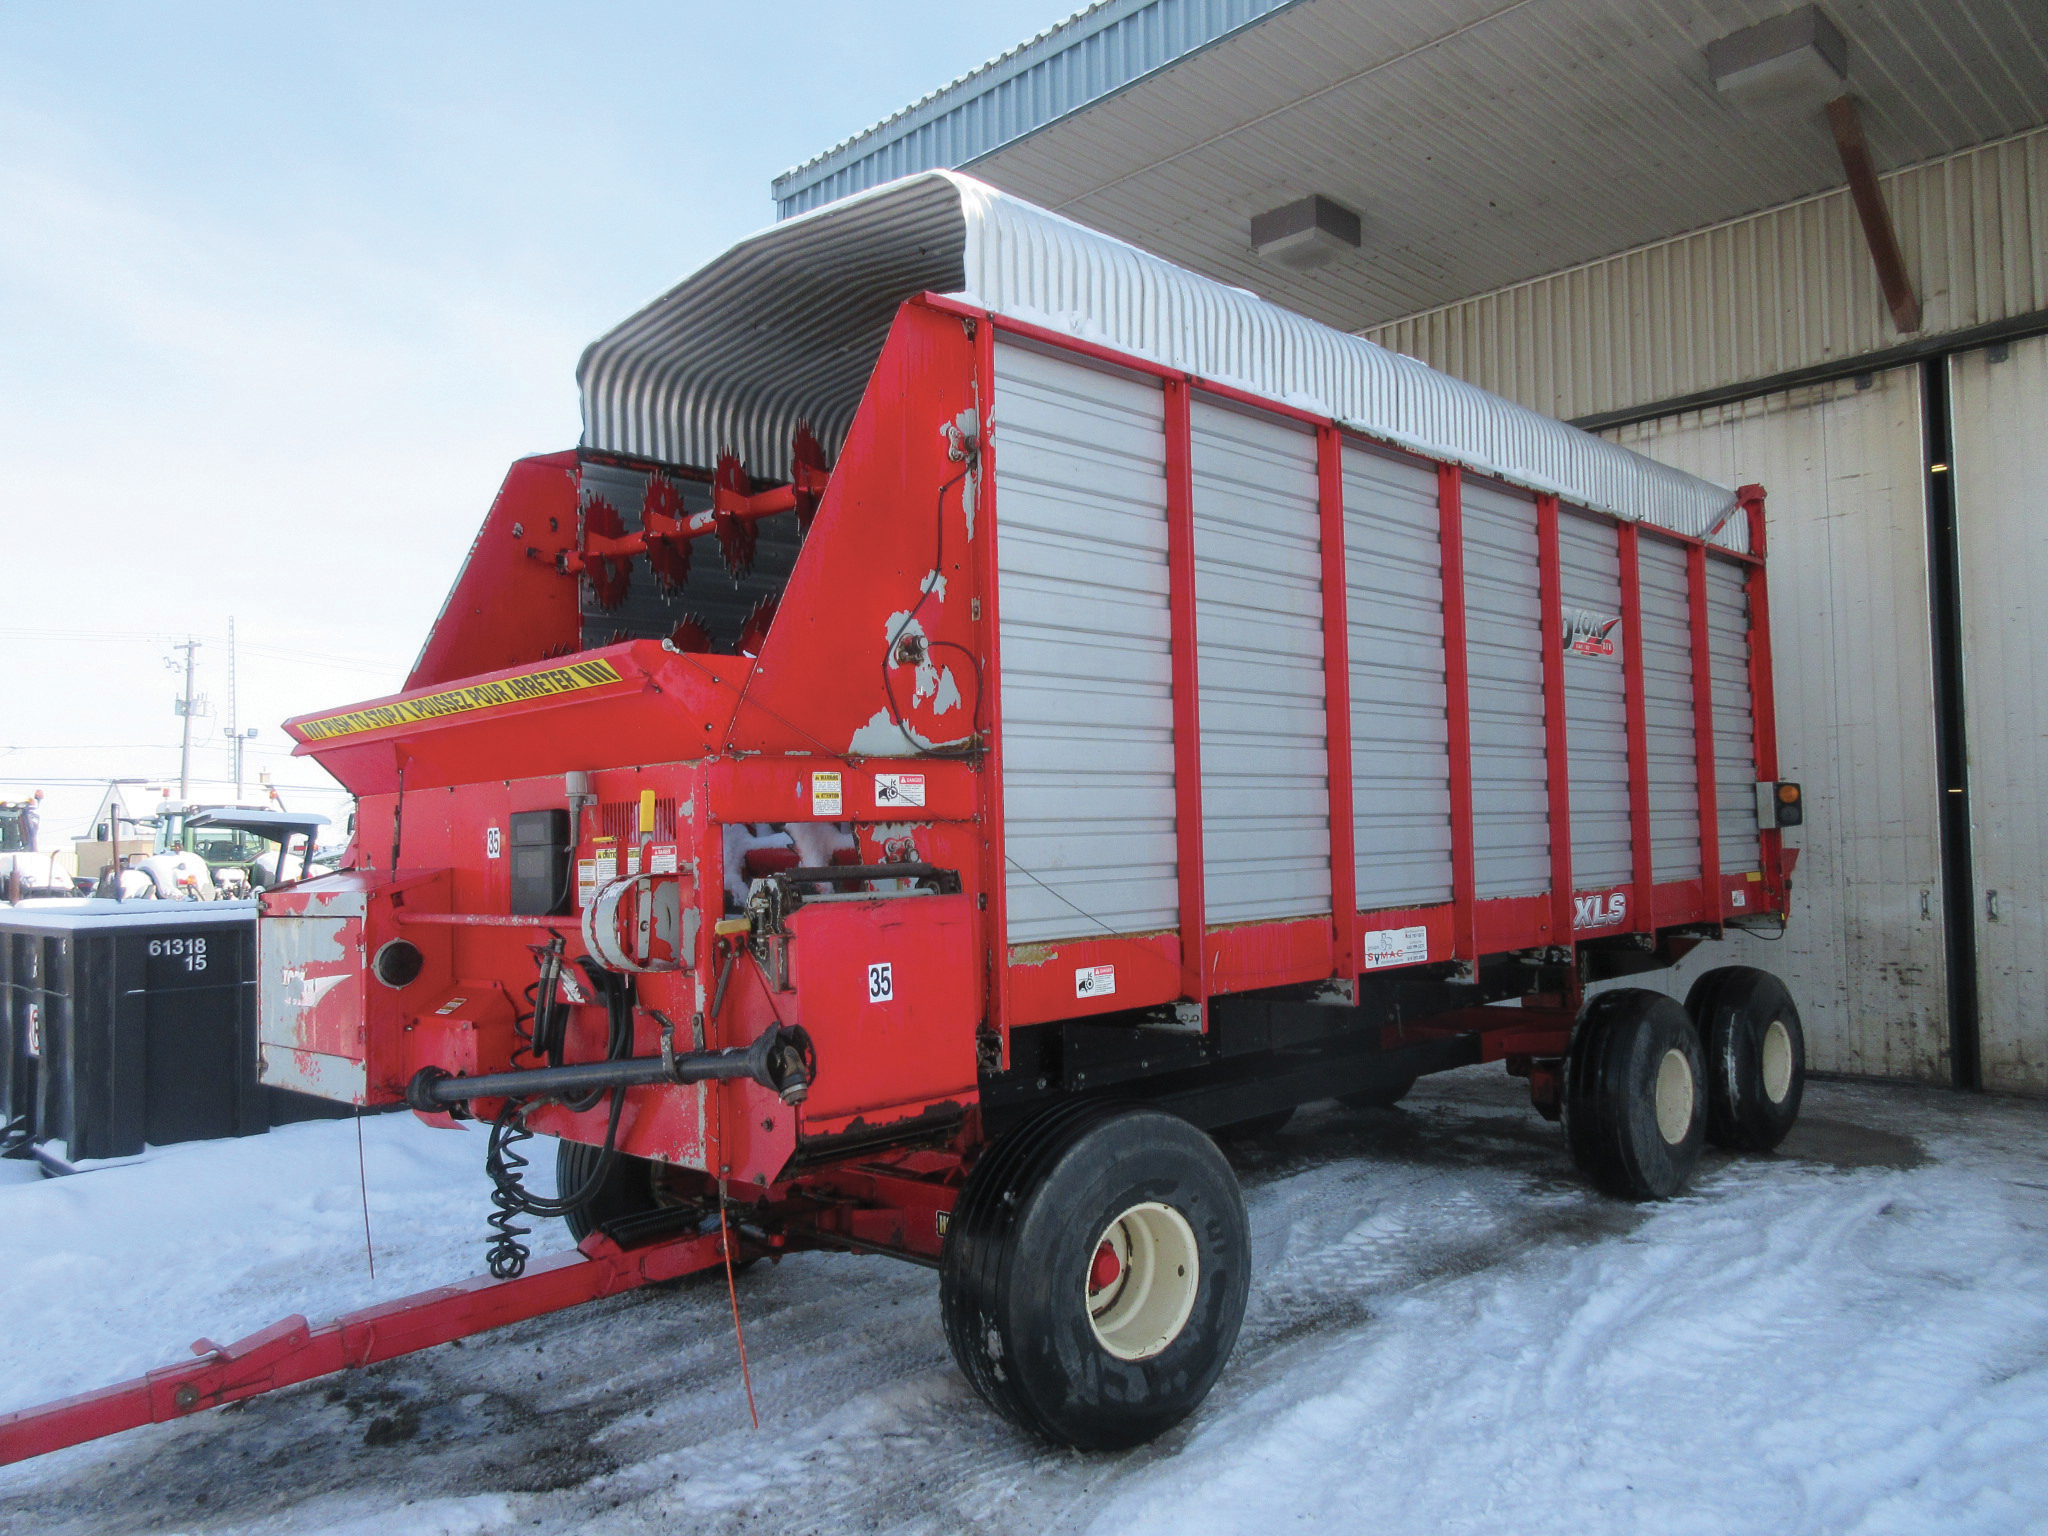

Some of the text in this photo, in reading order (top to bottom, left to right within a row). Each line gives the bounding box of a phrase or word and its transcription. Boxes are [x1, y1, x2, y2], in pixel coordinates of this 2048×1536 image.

[320, 716, 357, 735] PUSH
[347, 713, 371, 729] TO
[363, 707, 399, 727] STOP
[410, 691, 474, 717] POUSSEZ
[466, 683, 514, 706] POUR
[488, 830, 499, 854] 35
[1573, 893, 1626, 930] XLS
[149, 938, 207, 956] 61318
[185, 954, 207, 971] 15
[870, 966, 891, 997] 35
